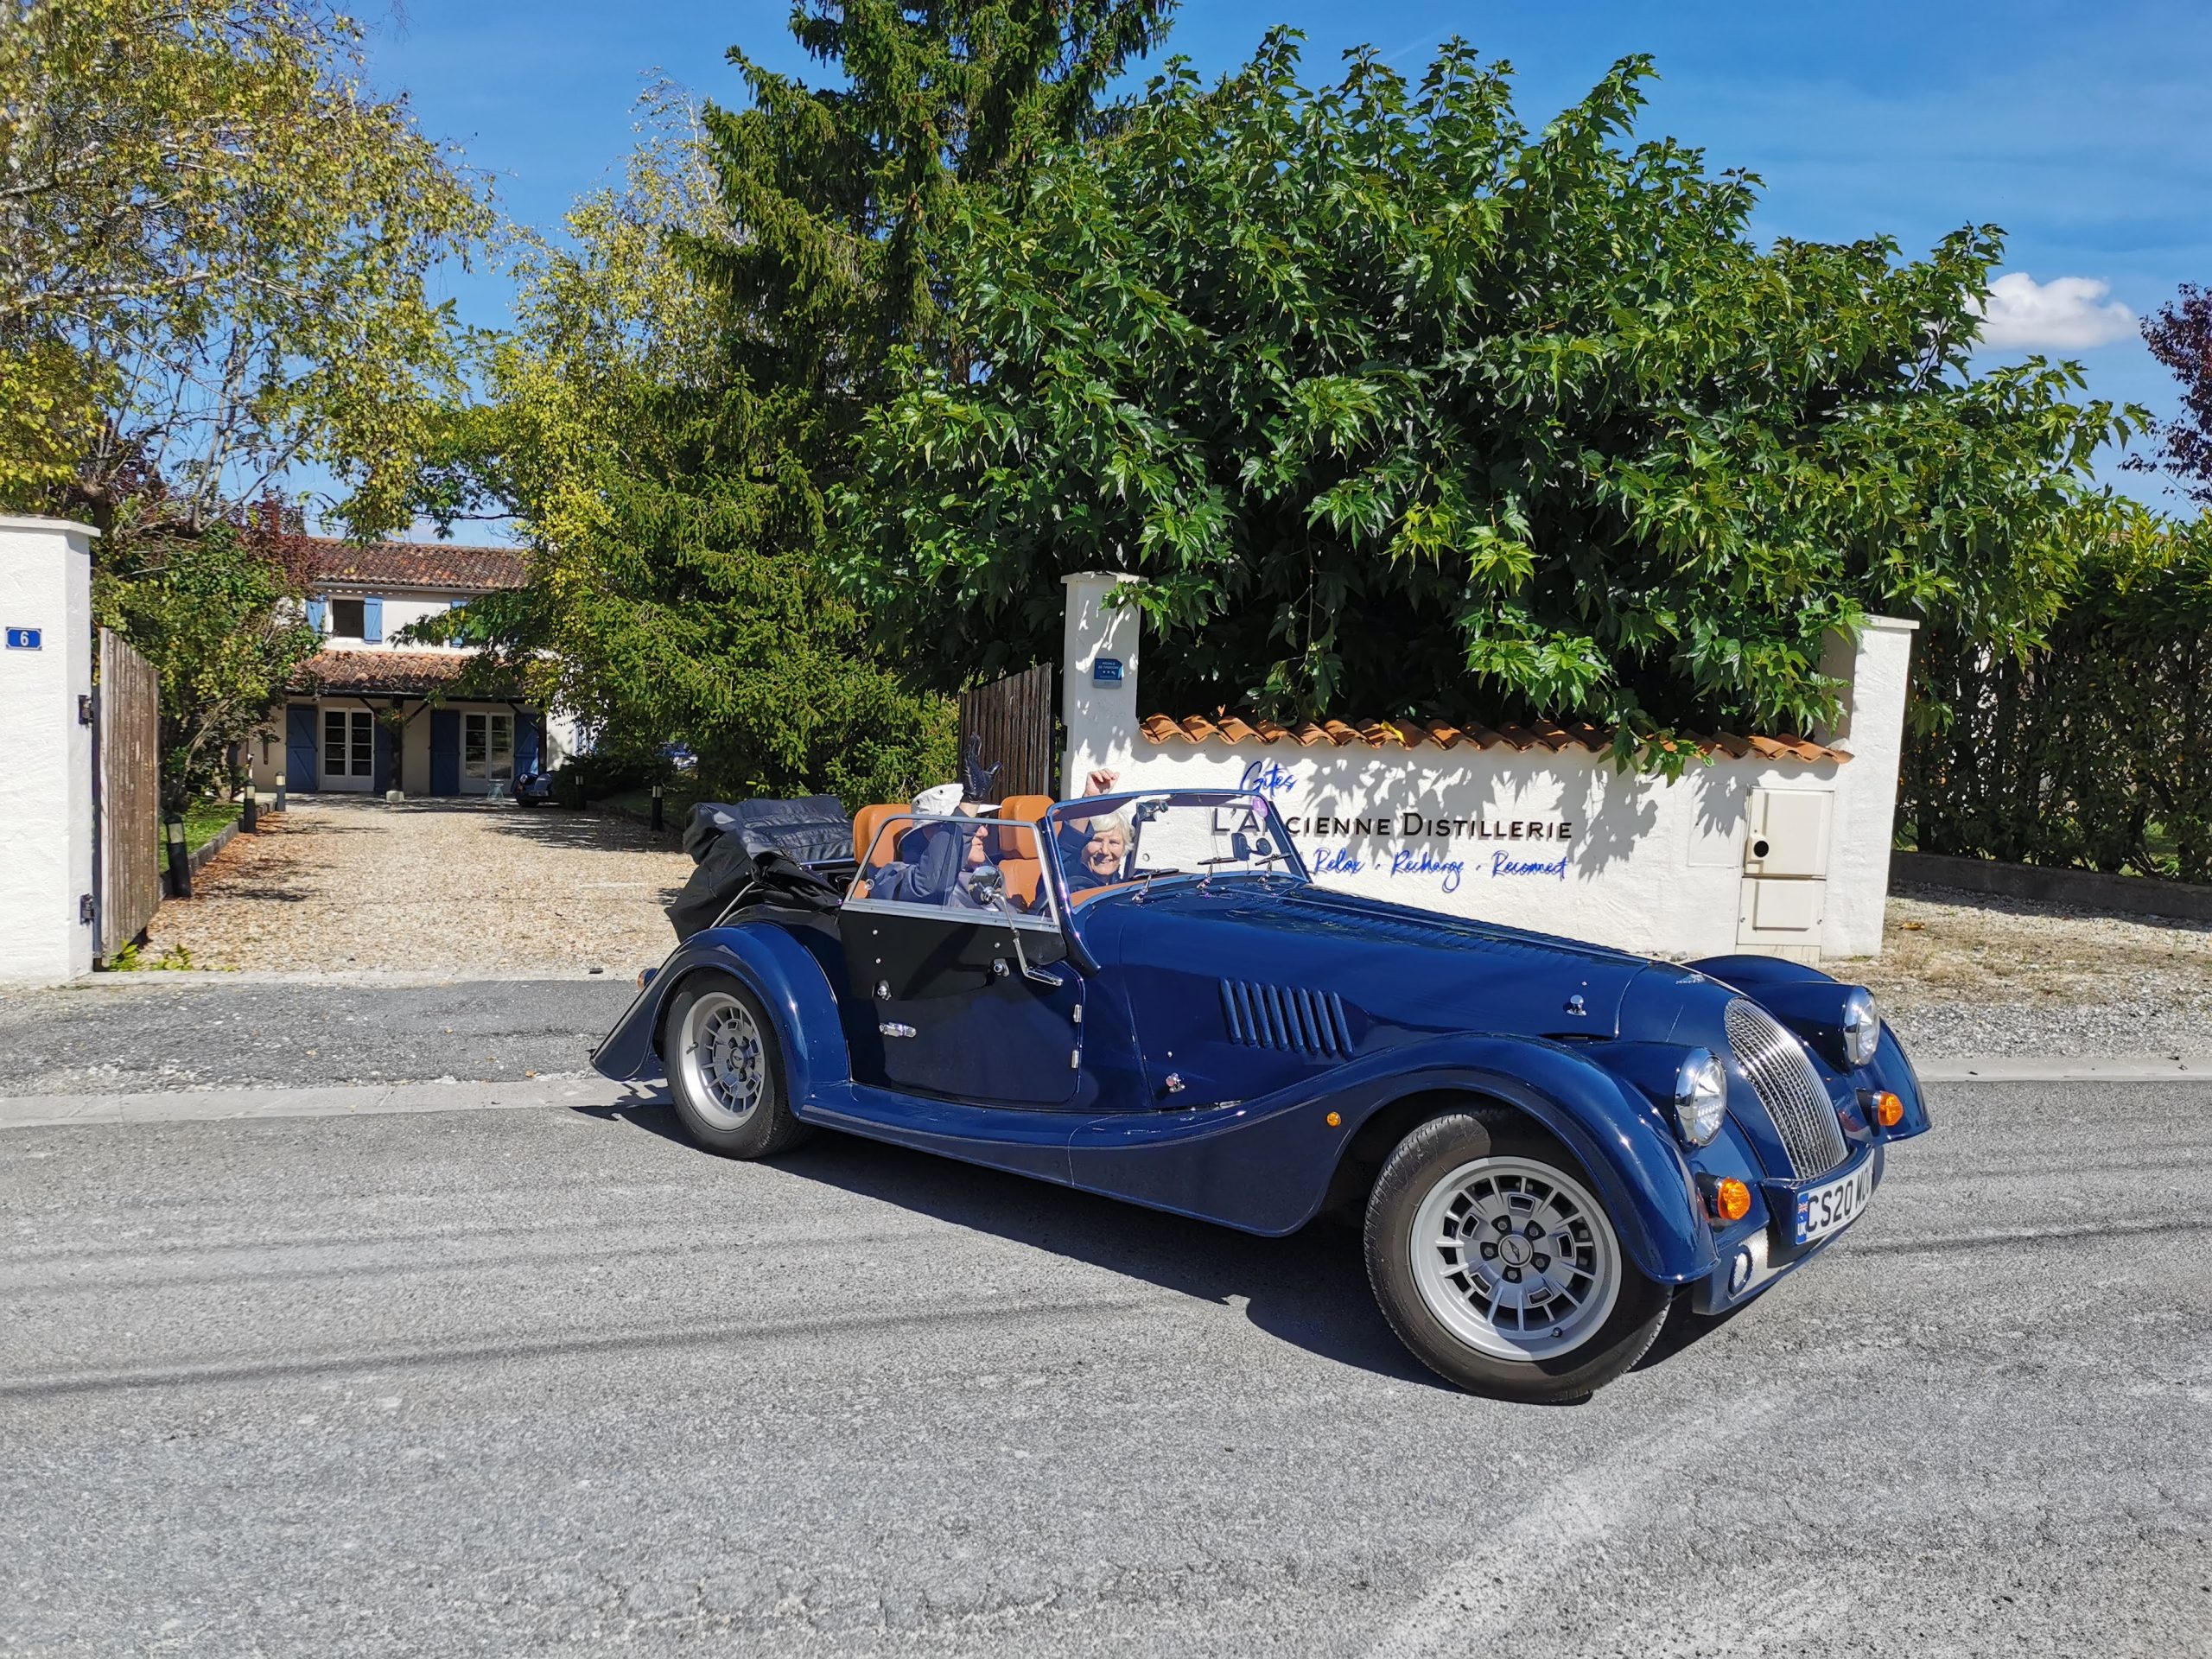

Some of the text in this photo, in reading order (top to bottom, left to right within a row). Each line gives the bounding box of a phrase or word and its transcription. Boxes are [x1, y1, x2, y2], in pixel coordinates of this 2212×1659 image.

[20, 631, 29, 646] 6
[1314, 848, 1363, 874] Relax
[1393, 851, 1464, 893] Recharge
[1806, 1179, 1853, 1233] CS20
